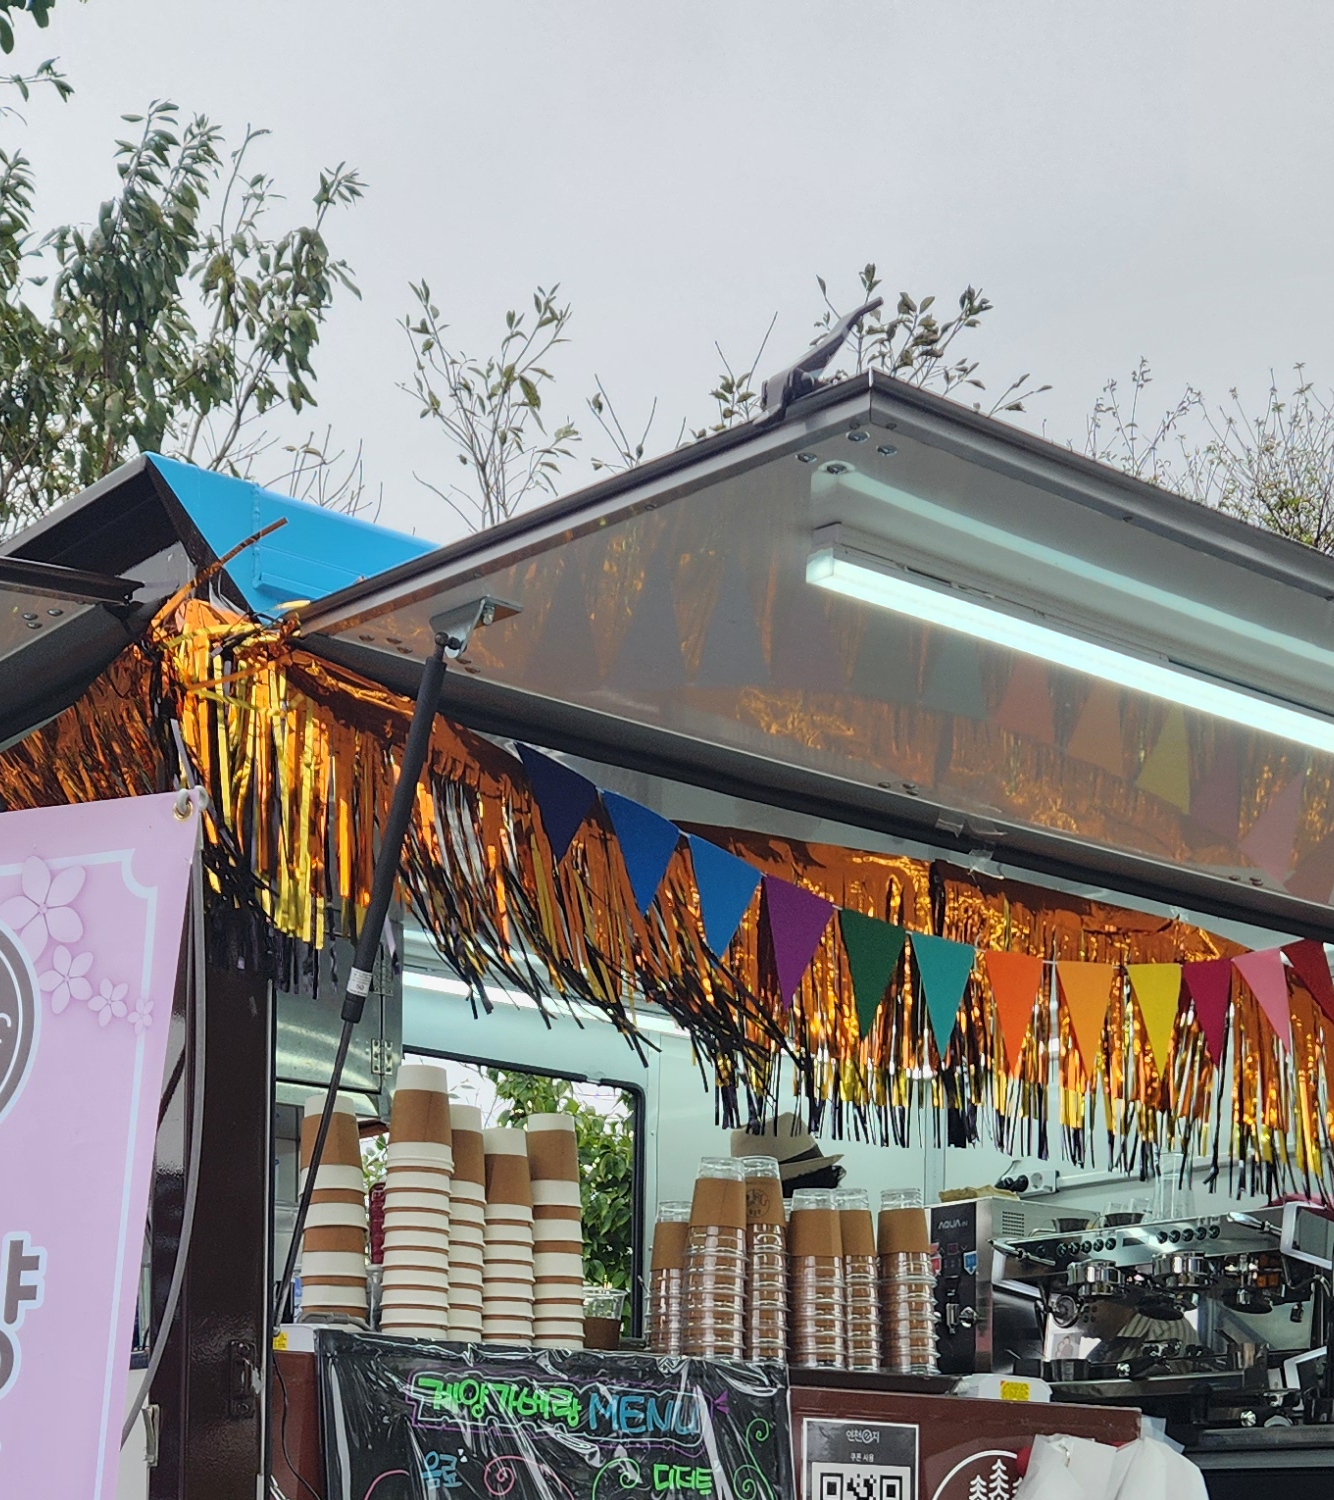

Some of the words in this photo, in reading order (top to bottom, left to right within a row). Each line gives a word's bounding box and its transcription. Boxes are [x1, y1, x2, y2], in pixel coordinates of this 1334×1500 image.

[589, 1392, 701, 1434] MENU
[421, 1451, 463, 1490] 음료
[652, 1463, 714, 1496] 디저트
